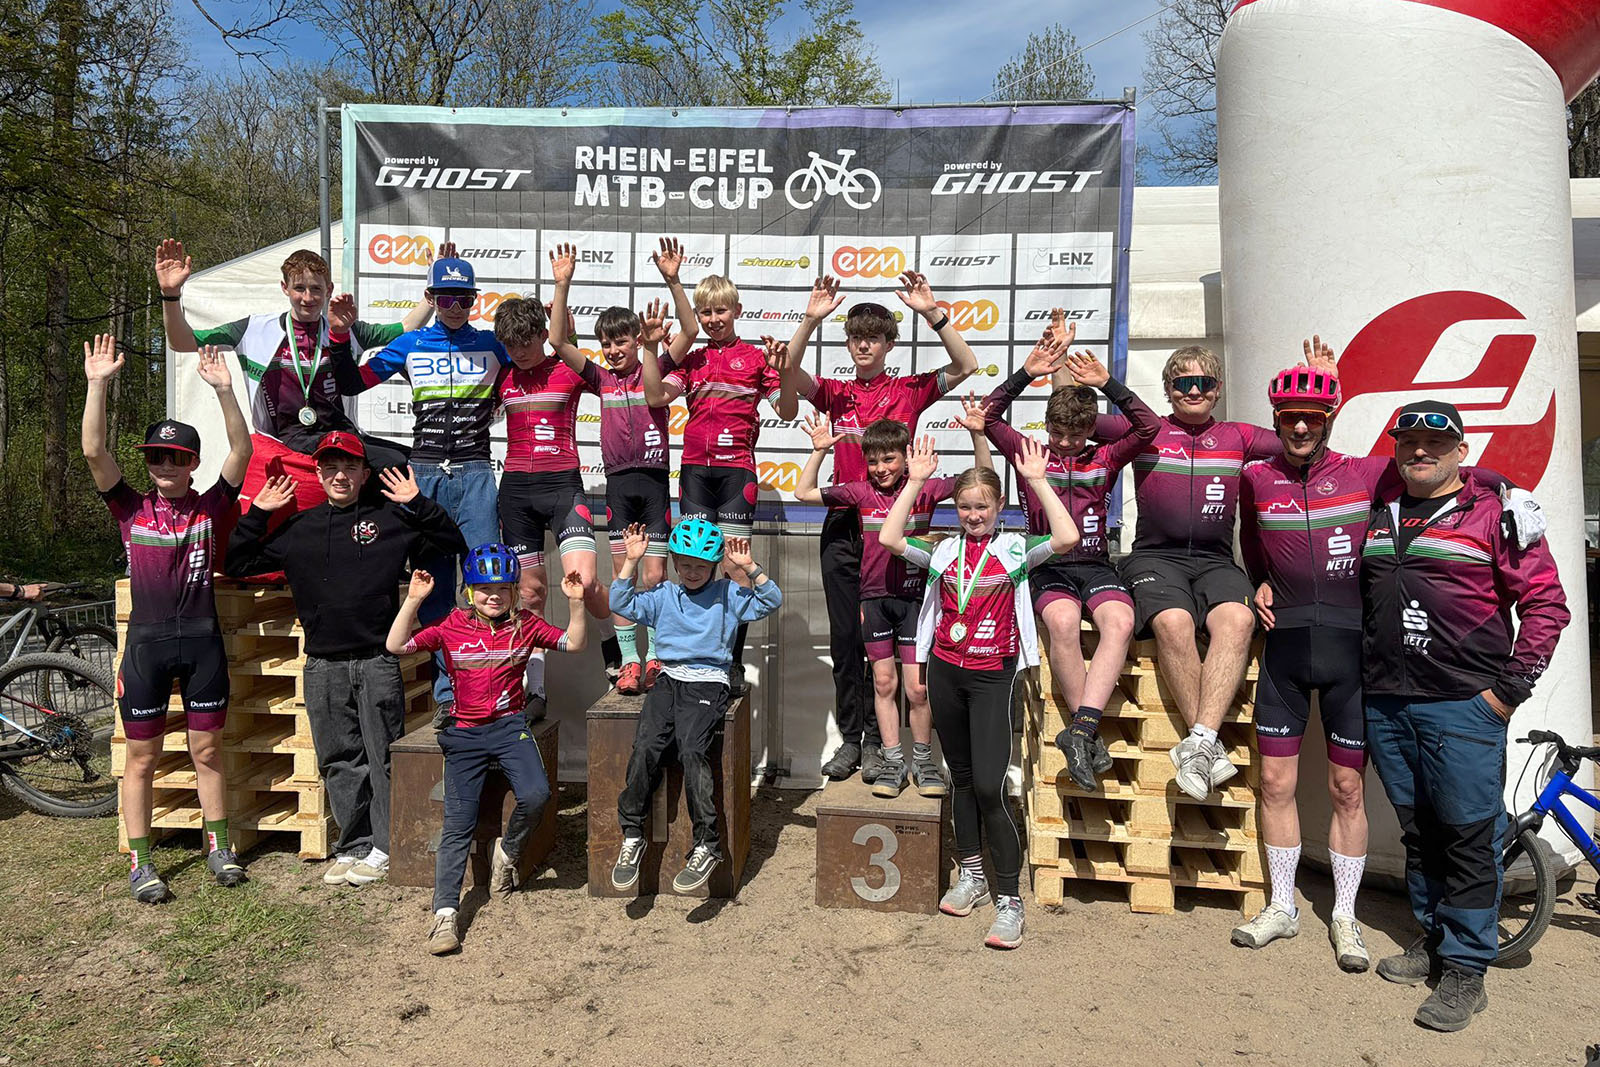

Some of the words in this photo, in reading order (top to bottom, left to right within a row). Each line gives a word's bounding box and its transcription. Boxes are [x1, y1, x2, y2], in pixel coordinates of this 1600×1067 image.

[384, 156, 425, 166] powered
[427, 156, 440, 166] by
[574, 146, 774, 173] RHEIN-EIFEL
[944, 161, 988, 172] powered
[990, 160, 1002, 171] by
[375, 168, 532, 190] GHOST
[930, 172, 1102, 195] GHOST
[574, 174, 774, 210] MTB-CUP
[460, 248, 526, 259] GHOST
[574, 250, 614, 264] ENZ
[1048, 252, 1094, 266] LENZ
[738, 258, 801, 268] stadler
[930, 255, 1000, 266] GHOST
[368, 300, 420, 309] stadle
[1202, 504, 1226, 514] NETT
[1326, 558, 1356, 570] NETT
[1331, 732, 1361, 746] DURWEN
[850, 823, 901, 902] 3
